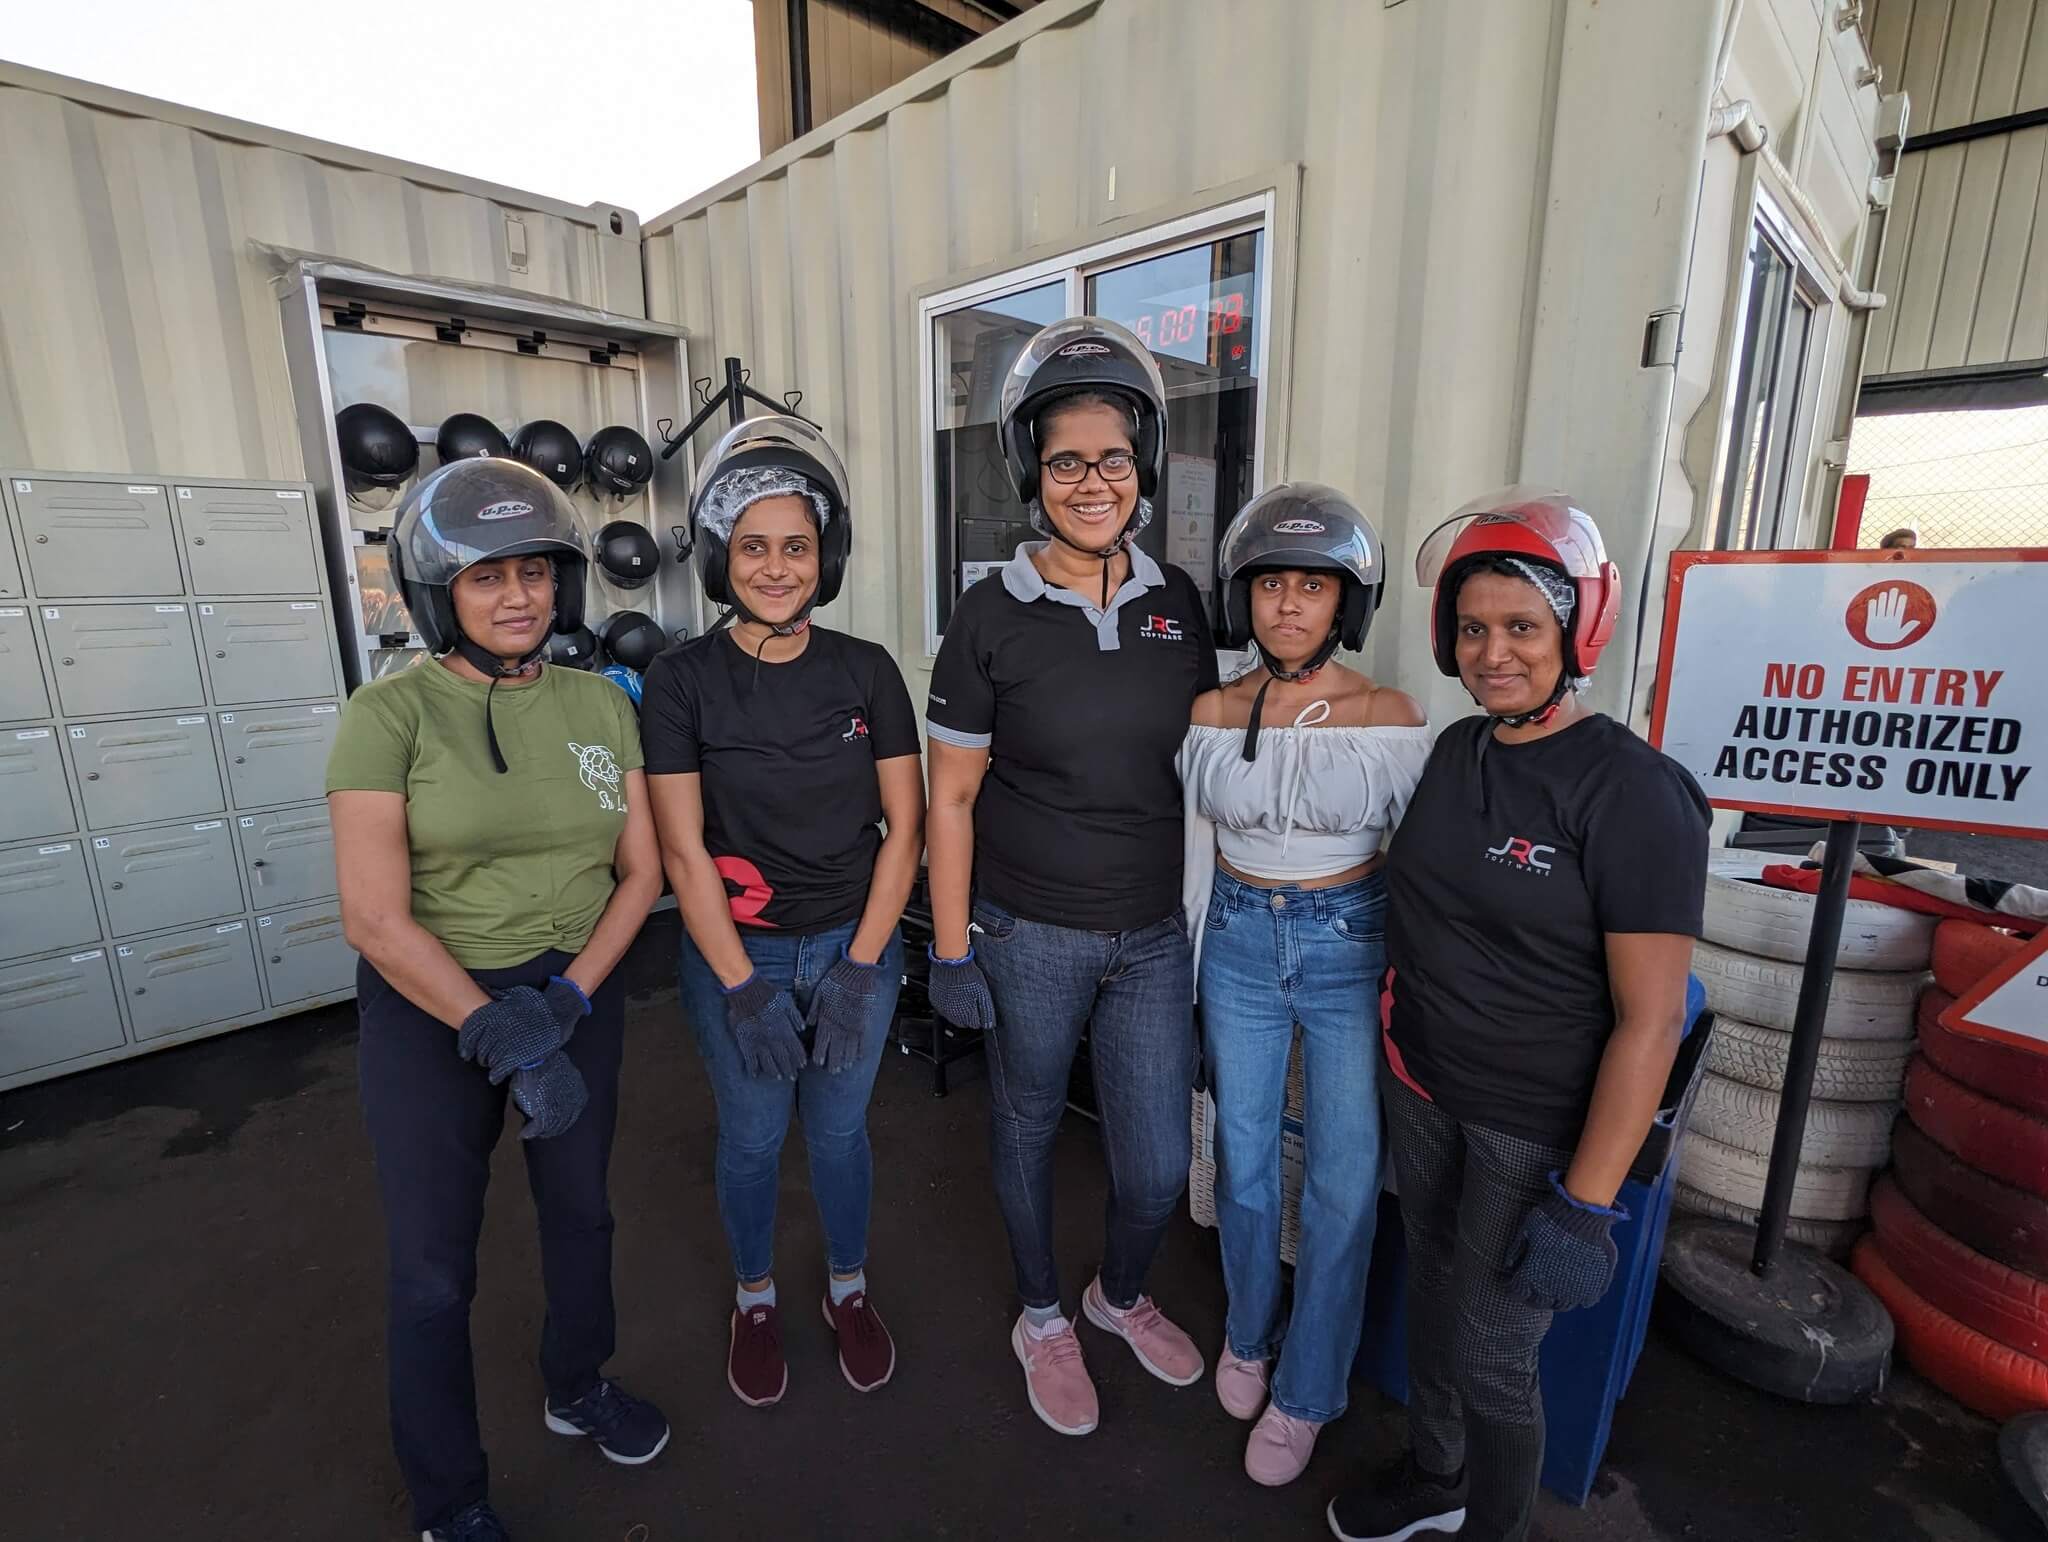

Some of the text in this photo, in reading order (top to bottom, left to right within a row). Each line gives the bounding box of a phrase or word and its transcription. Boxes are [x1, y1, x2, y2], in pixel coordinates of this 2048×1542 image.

[1140, 614, 1183, 634] JRC
[1762, 662, 2005, 708] NO ENTRY
[1732, 704, 2023, 756] AUTHORIZED
[1712, 744, 2033, 802] ACCESS ONLY
[97, 839, 108, 847] 15
[1487, 837, 1555, 870] JRC
[1484, 852, 1551, 877] SOFTWARE
